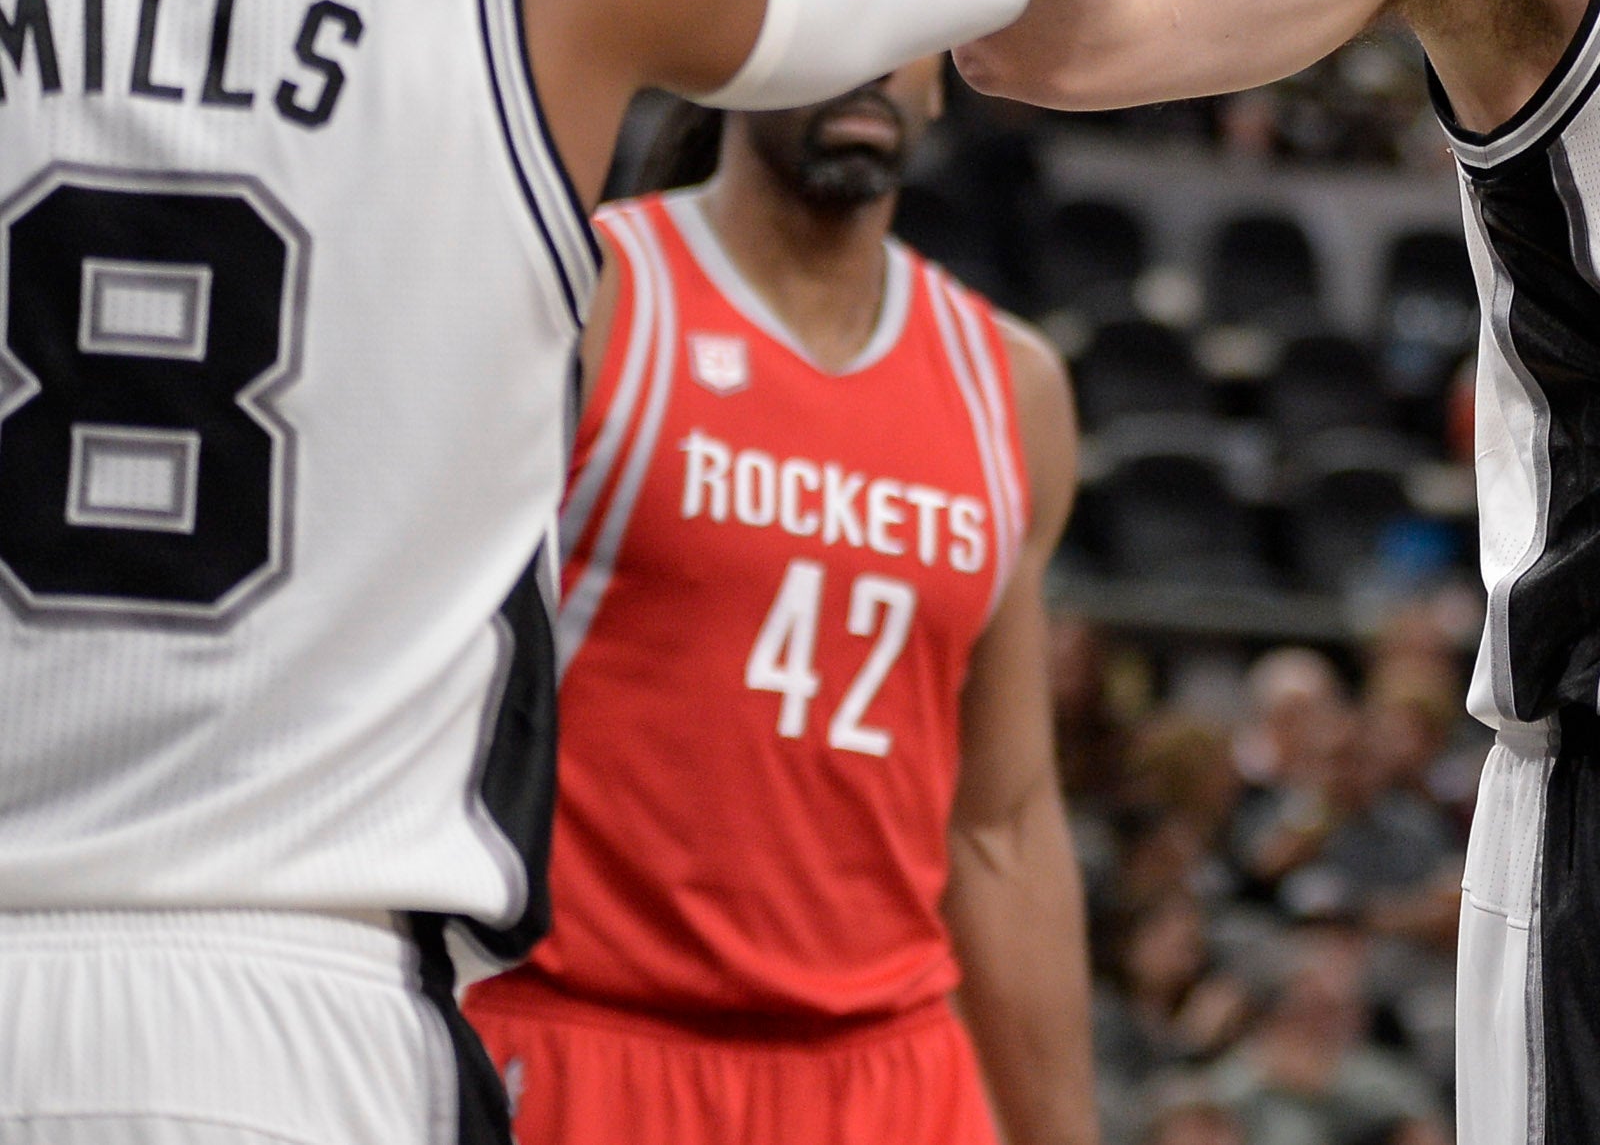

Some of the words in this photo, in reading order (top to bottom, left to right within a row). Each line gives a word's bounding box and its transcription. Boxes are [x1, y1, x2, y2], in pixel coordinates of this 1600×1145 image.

[0, 159, 312, 634] 8
[679, 427, 988, 574] ROCKETS
[744, 557, 917, 758] 42
